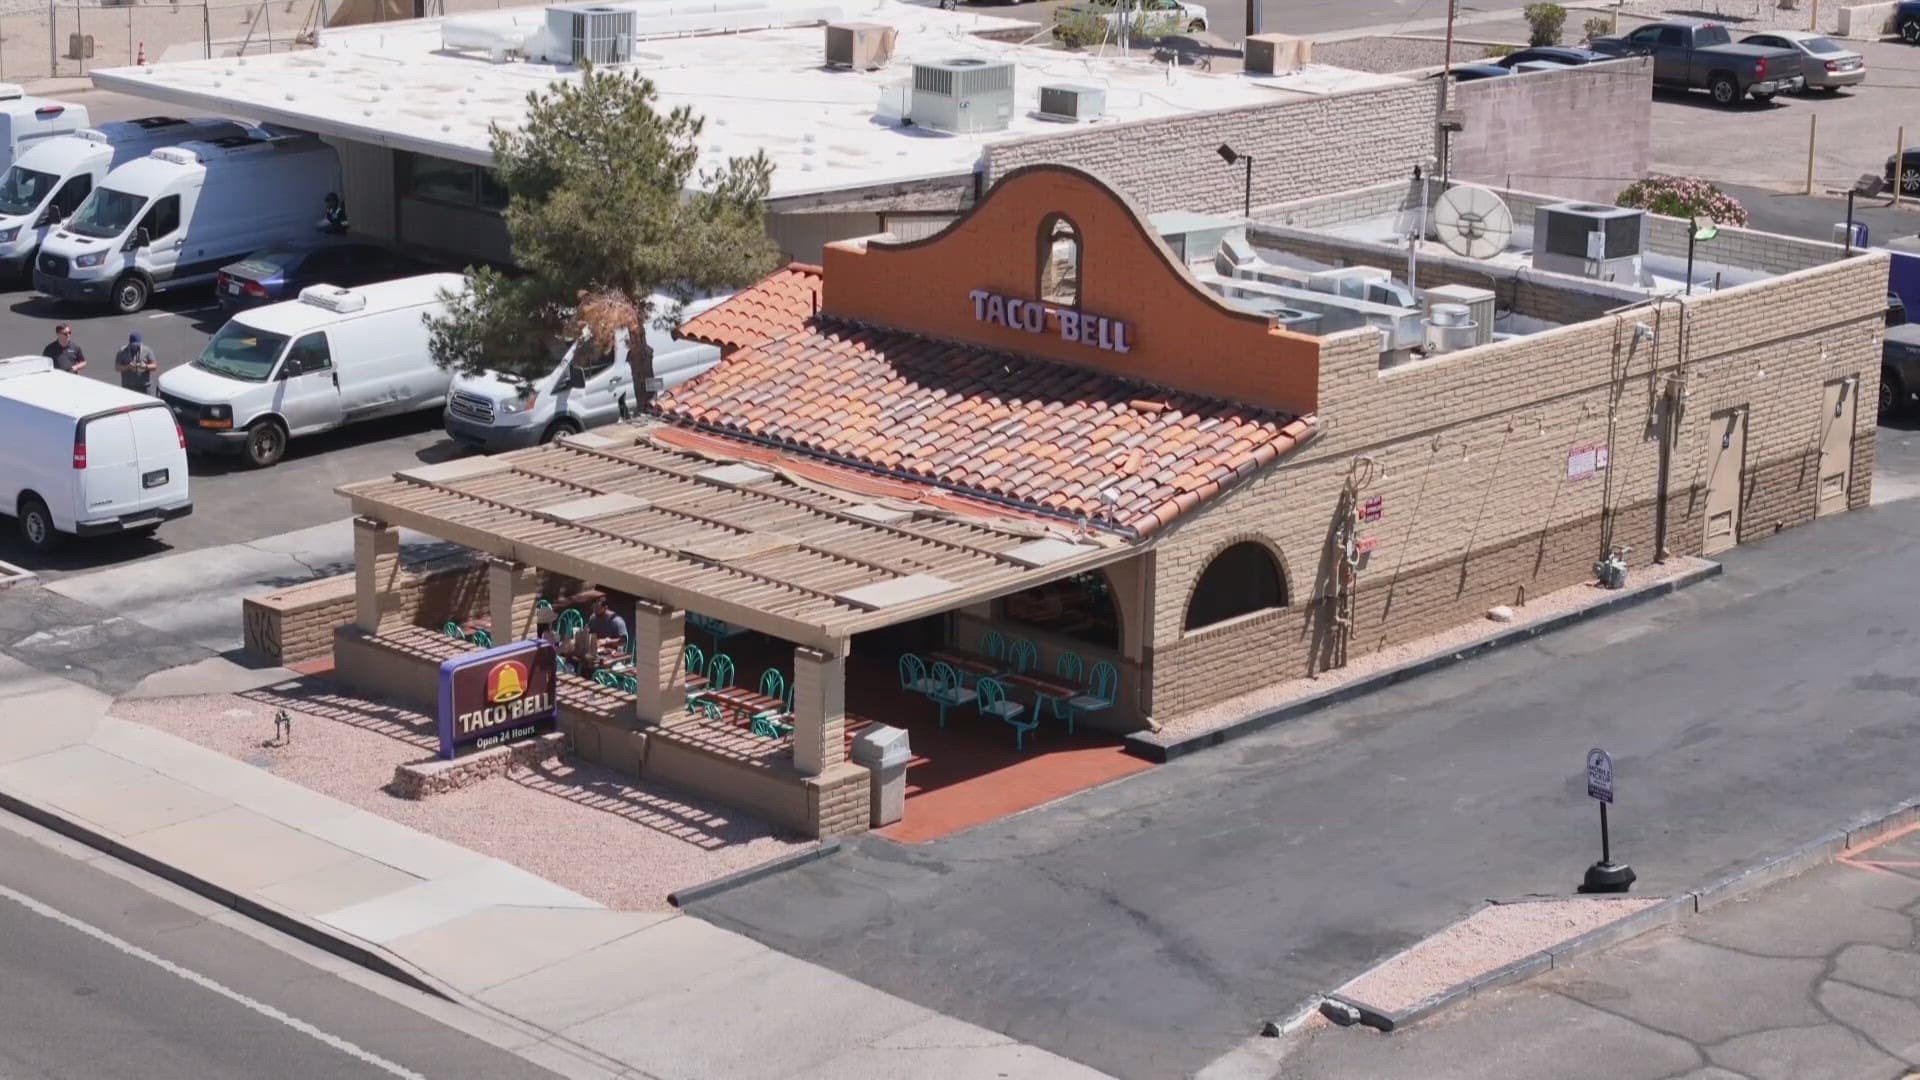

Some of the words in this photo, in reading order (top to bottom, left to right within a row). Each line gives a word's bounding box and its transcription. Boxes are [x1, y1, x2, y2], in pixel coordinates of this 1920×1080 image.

[969, 289, 1046, 334] TACO
[1055, 308, 1131, 353] BELL
[459, 705, 507, 733] TACO
[508, 692, 553, 720] BELL
[476, 734, 498, 749] Open
[500, 730, 510, 741] 24
[512, 725, 535, 738] Hours
[1589, 765, 1611, 778] MOBILE
[1589, 771, 1611, 783] PICKUP
